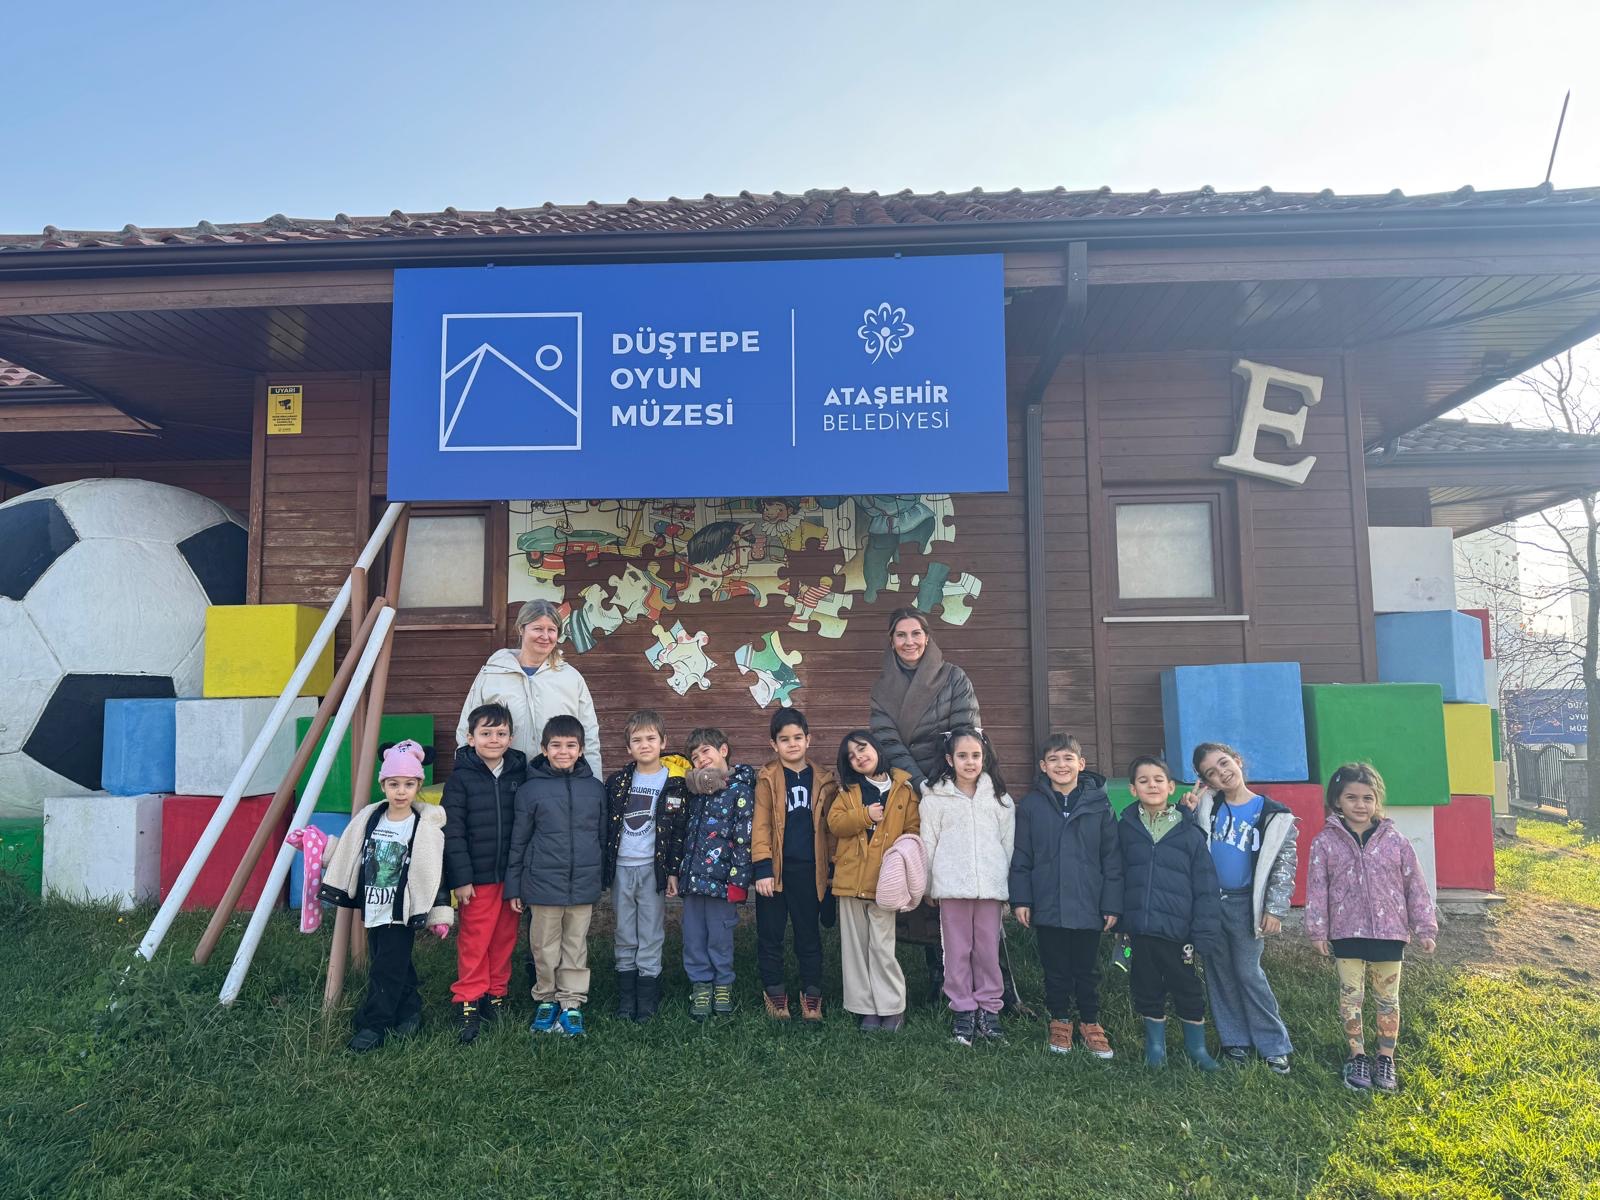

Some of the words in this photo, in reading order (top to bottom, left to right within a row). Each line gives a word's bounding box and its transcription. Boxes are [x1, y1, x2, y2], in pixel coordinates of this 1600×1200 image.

[612, 326, 760, 360] DÜŞTEPE
[610, 367, 701, 390] OYUN
[823, 380, 949, 410] ATAŞEHİR
[611, 398, 734, 427] MÜZESİ
[823, 409, 949, 432] BELEDİYESİ
[1213, 358, 1324, 486] E
[630, 786, 660, 795] GWARTS
